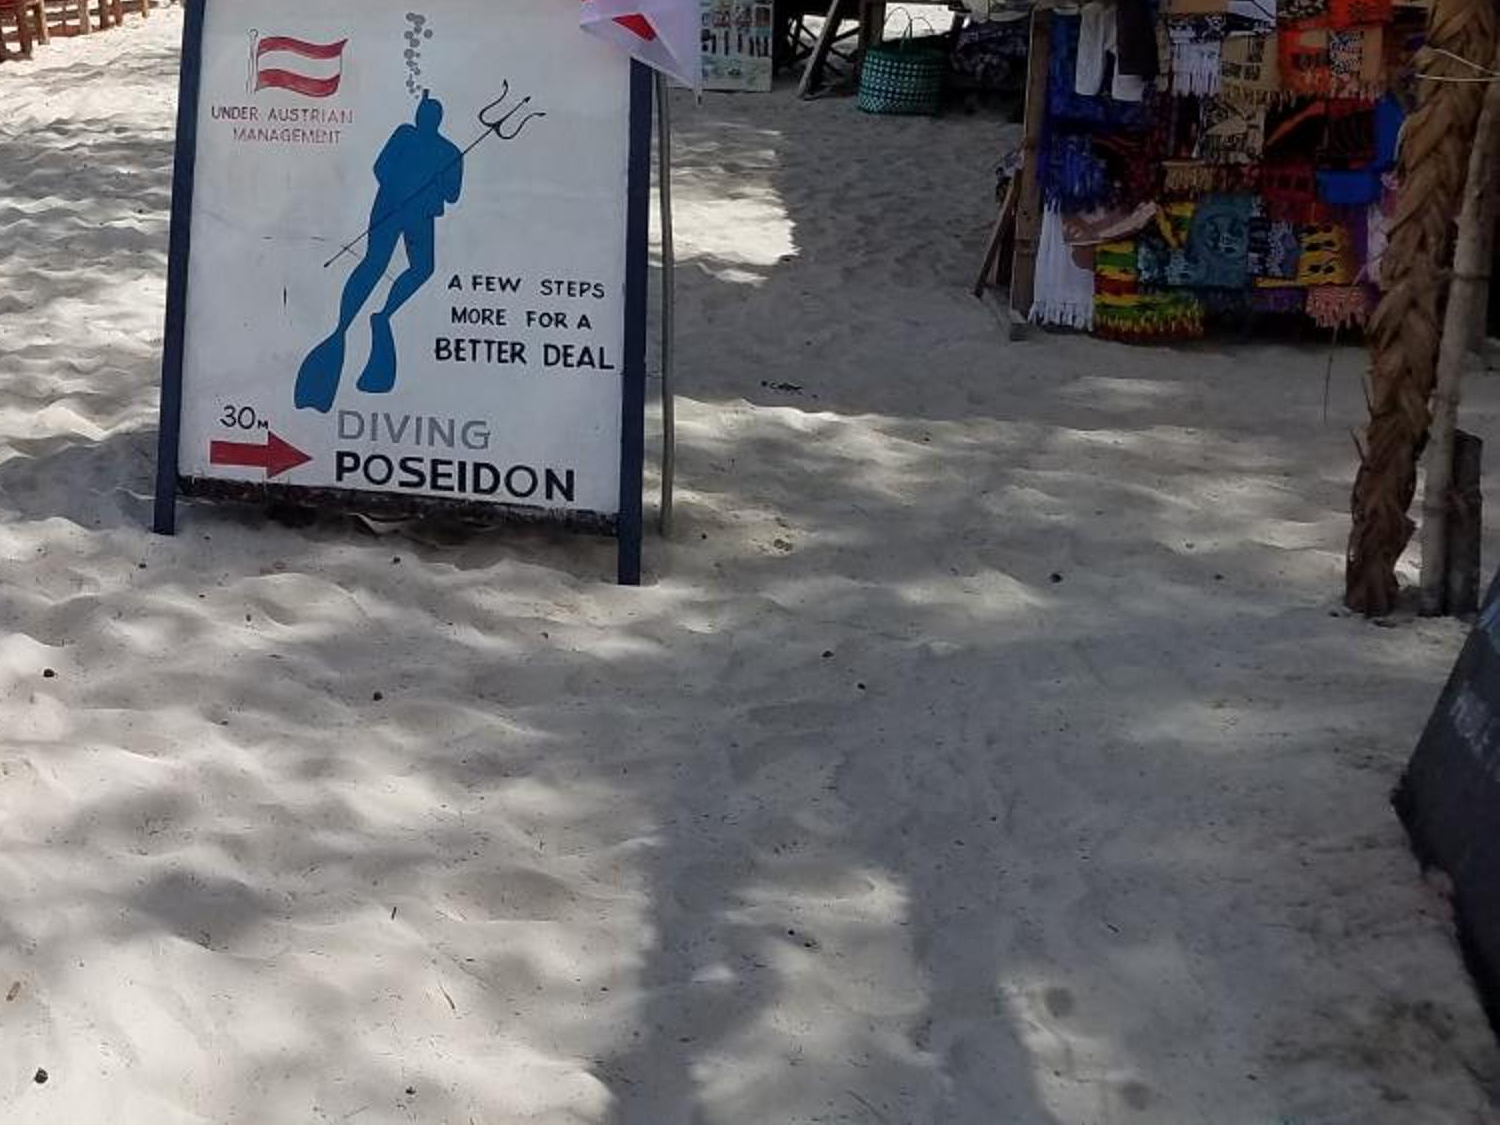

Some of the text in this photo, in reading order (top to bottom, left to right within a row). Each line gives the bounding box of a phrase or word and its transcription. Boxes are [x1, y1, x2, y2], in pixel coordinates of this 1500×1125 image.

[211, 106, 353, 124] UNDER AUSTRIAN
[233, 128, 341, 144] MANAGEMENT
[448, 275, 605, 299] A FEW STEPS
[451, 306, 592, 329] MORE FOR A
[435, 337, 615, 370] BETTER DEAL
[337, 409, 491, 450] DIVING
[335, 450, 575, 502] POSEIDON
